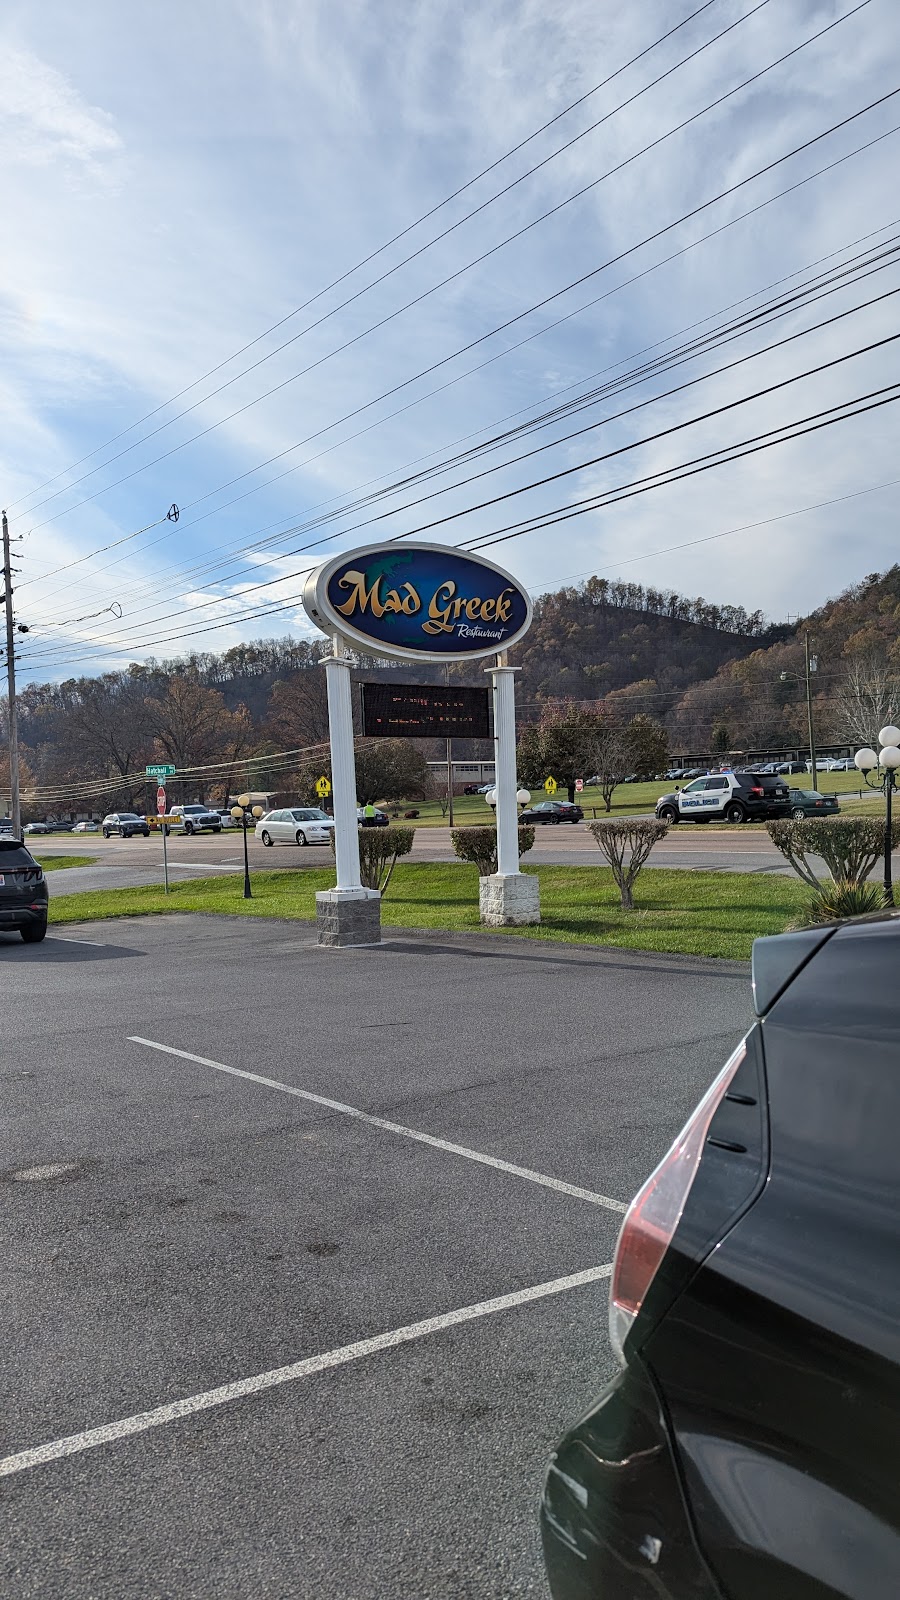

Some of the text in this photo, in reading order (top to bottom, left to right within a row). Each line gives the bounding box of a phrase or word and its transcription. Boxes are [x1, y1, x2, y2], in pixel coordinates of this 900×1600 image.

[334, 570, 515, 634] Mad Greek
[456, 623, 508, 640] Restaurant
[682, 798, 720, 807] POLICE
